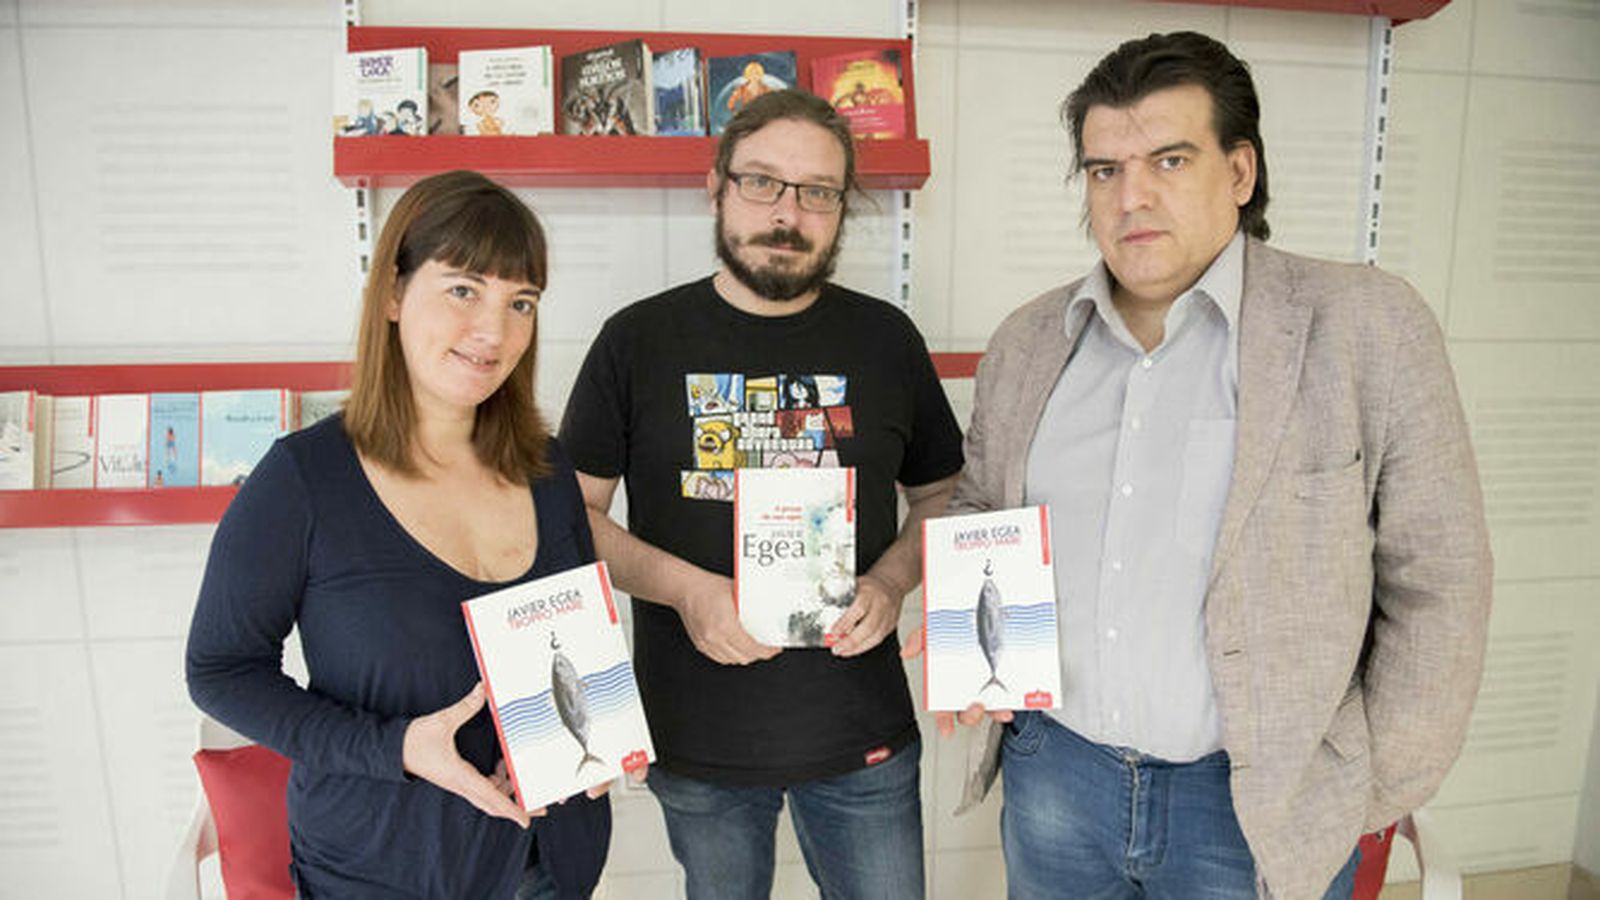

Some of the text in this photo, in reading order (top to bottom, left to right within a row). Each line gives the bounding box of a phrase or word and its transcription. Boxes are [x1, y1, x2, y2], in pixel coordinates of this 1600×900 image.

[954, 526, 1020, 543] JAVIER EGEA
[743, 534, 806, 567] Egea
[507, 589, 582, 621] JAVIER EGEA
[510, 600, 583, 629] TROPPO MARE
